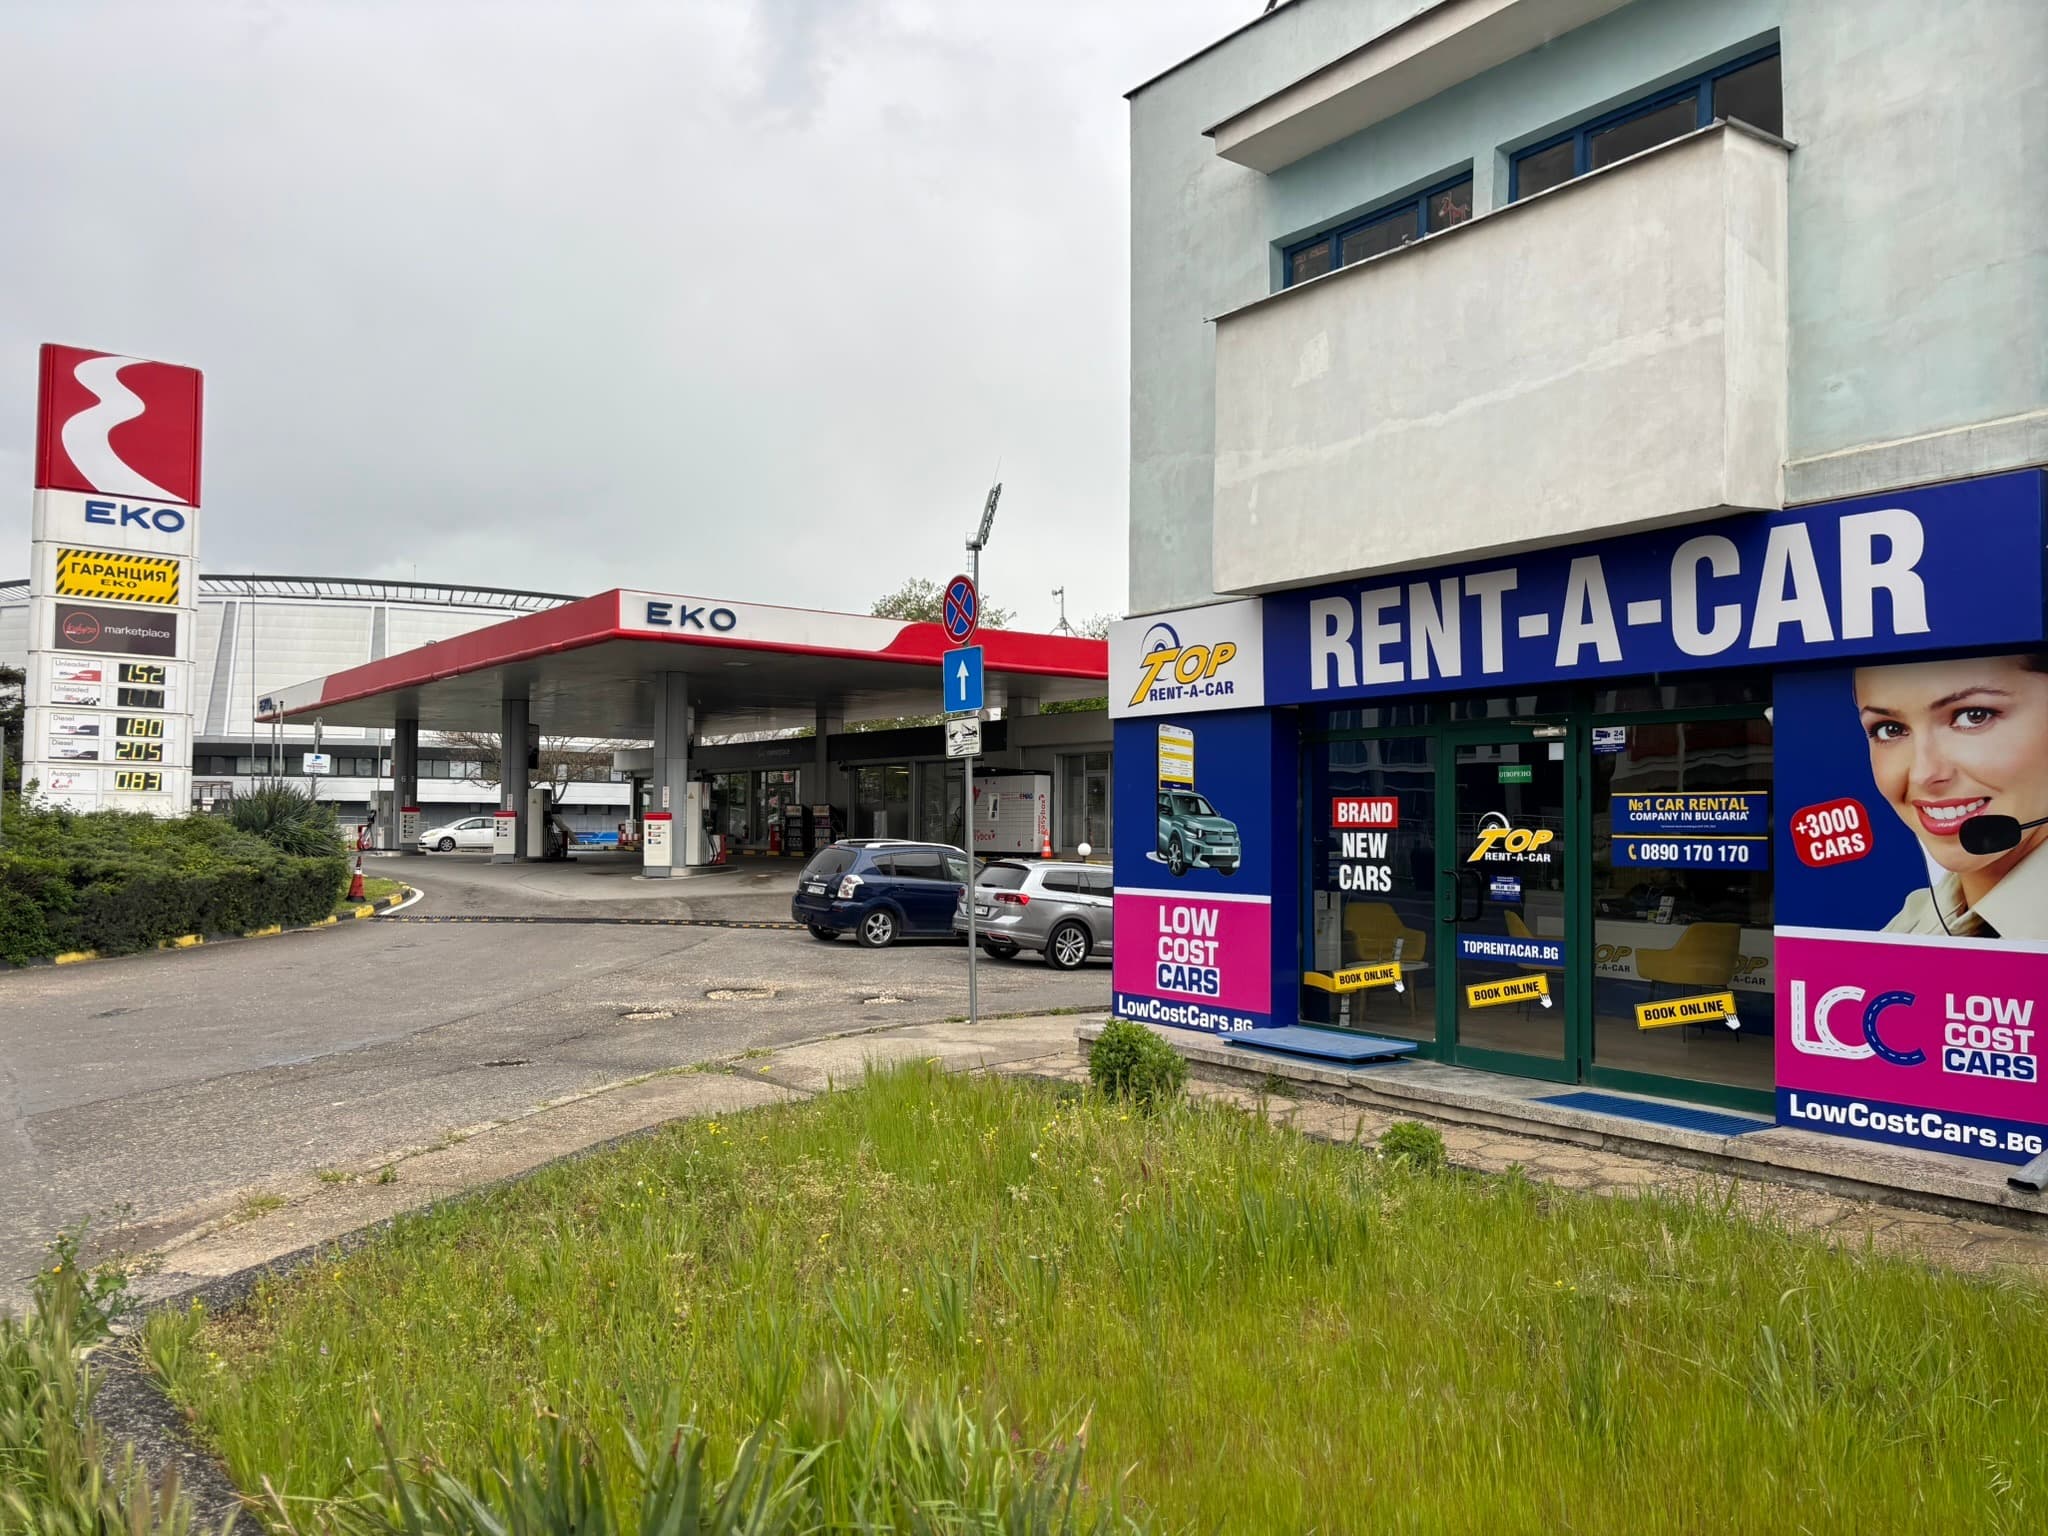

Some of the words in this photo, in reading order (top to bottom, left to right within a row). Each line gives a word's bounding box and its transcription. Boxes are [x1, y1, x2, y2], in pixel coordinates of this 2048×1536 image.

[85, 500, 185, 533] EKO
[71, 561, 167, 583] ГАРАНЦИЯ
[1310, 507, 1931, 691] RENT-A-CAR
[646, 601, 737, 632] EKO
[104, 624, 171, 640] marketplace
[1128, 641, 1238, 709] TOP
[1149, 680, 1235, 703] RENT-A-CAR
[53, 713, 75, 722] Diesel
[51, 738, 74, 747] Diesel
[1613, 729, 1624, 737] 24
[1337, 802, 1394, 823] BRAND
[1629, 811, 1679, 821] COMPANY
[1681, 811, 1693, 821] IN
[1654, 798, 1686, 811] CAR
[1689, 797, 1750, 811] RENTAL
[1795, 804, 1859, 839] +3000
[1341, 832, 1389, 859] NEW
[1467, 827, 1554, 863] TOP
[1484, 852, 1551, 863] RENT-A-CAR
[1640, 843, 1679, 861] 0890
[1683, 844, 1714, 862] 170
[1718, 845, 1749, 862] 170
[1810, 832, 1866, 861] CARS
[1339, 864, 1392, 892] CARS
[1159, 905, 1219, 938] LOW
[1158, 936, 1219, 967] COST
[1462, 940, 1559, 960] TOPRENTACAR.BG
[1595, 943, 1633, 964] OP
[1159, 963, 1219, 996] CARS
[1339, 972, 1362, 985] BOOK
[1364, 968, 1394, 982] ONLINE
[1473, 988, 1501, 1001] BOOK
[1503, 981, 1539, 996] ONLINE
[1118, 994, 1254, 1032] LowCostCars.BG
[1643, 1005, 1677, 1021] BOOK
[1679, 999, 1724, 1016] ONLINE
[1790, 979, 1927, 1067] LCC
[1945, 992, 2034, 1027] LOW
[1944, 1022, 2035, 1053] COST
[1943, 1048, 2035, 1081] CARS
[1790, 1093, 2043, 1155] LowCostCars.BG
